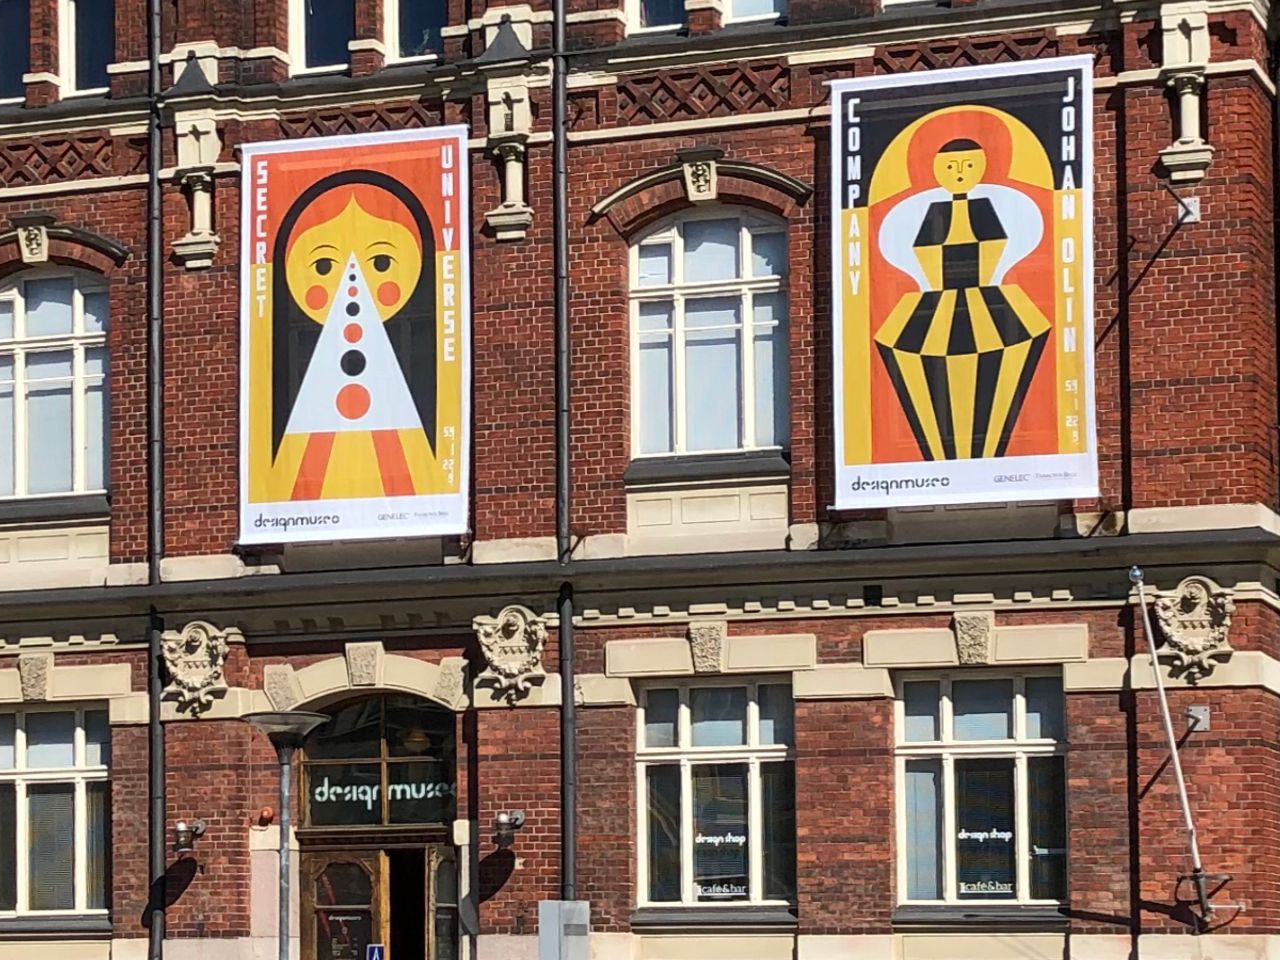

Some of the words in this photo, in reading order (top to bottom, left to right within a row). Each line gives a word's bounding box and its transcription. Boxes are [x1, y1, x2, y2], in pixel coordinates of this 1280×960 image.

[847, 98, 861, 296] COMPANY
[1061, 76, 1076, 221] JOHAN
[255, 160, 268, 319] SECRET
[440, 144, 456, 362] UNIVERSE
[1061, 237, 1077, 353] OLIN
[254, 513, 340, 532] designmuseo
[851, 476, 950, 495] designmuseo
[695, 832, 724, 846] design
[725, 832, 746, 846] shop
[958, 828, 989, 842] design
[990, 828, 1013, 842] shop
